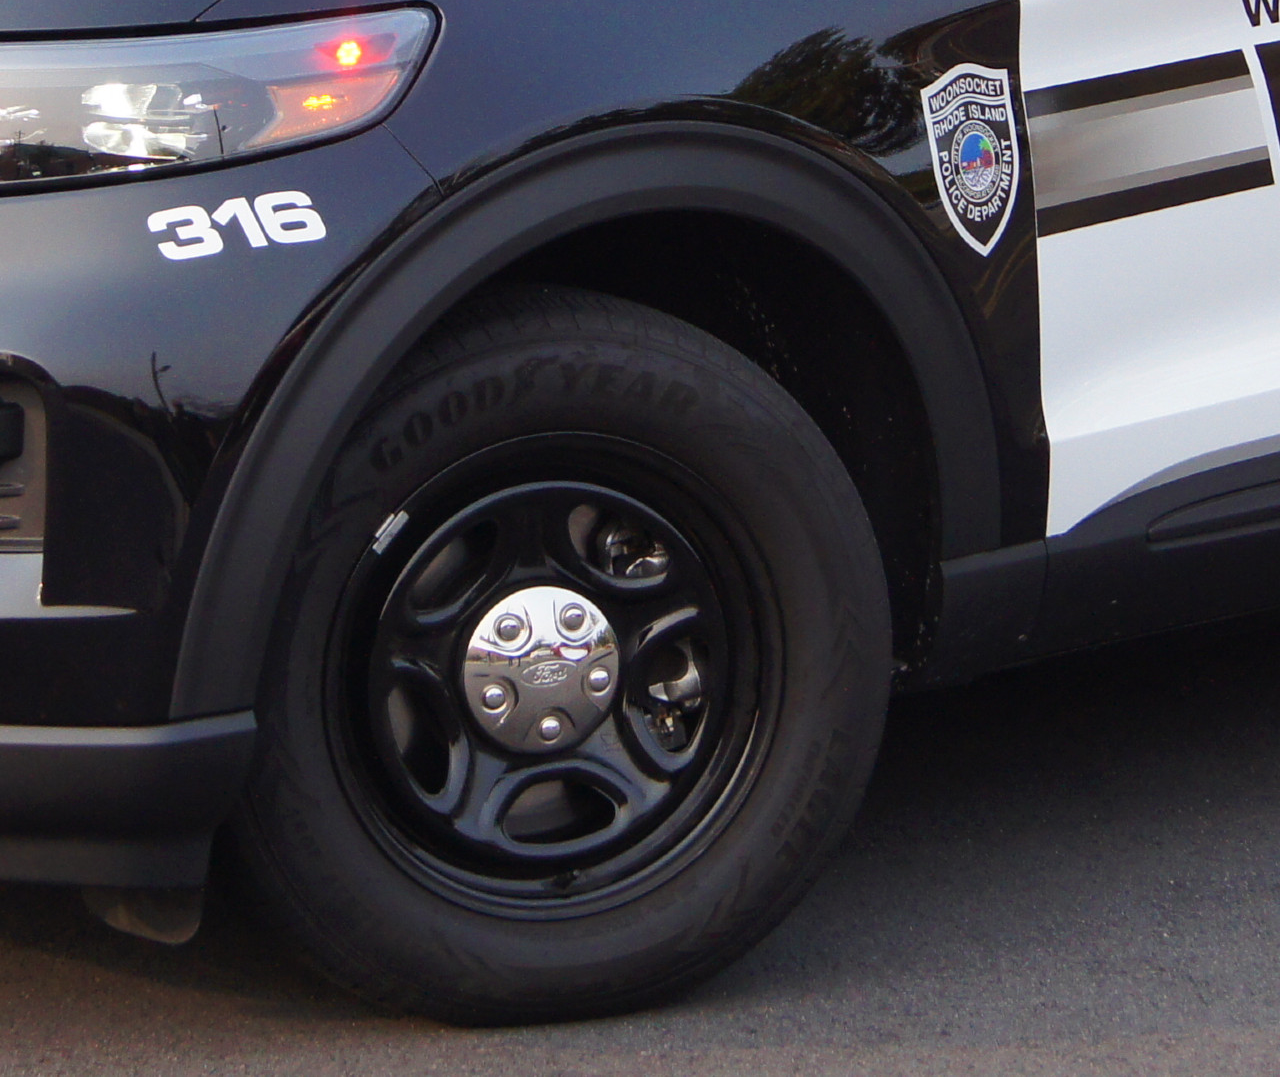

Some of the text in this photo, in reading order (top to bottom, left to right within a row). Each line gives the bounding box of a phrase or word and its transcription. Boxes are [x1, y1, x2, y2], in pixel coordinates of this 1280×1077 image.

[930, 78, 1002, 111] WOONSOCKET
[934, 105, 1006, 139] RHODE ISLAND
[939, 139, 1011, 222] POLICE DEPARTMENT
[147, 191, 326, 261] 316
[533, 664, 567, 684] Ford
